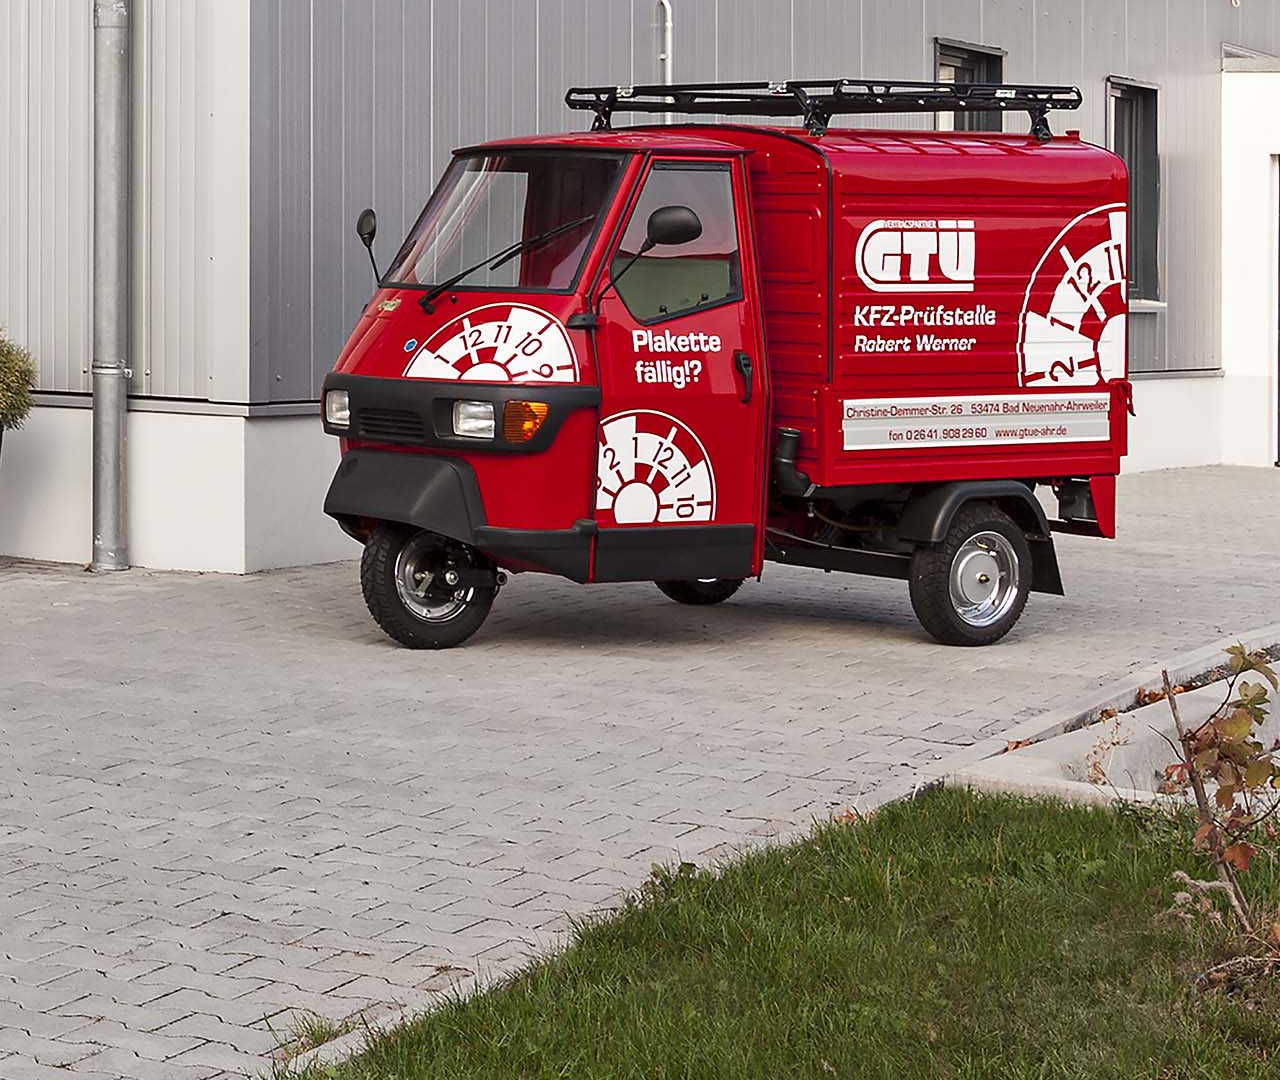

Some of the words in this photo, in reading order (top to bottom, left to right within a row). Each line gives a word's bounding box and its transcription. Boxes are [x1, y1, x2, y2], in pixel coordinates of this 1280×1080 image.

[863, 220, 975, 281] GTÜ
[1068, 262, 1101, 303] 12
[854, 305, 996, 326] KFZ-Prüfstelle
[460, 329, 484, 350] 12
[494, 325, 512, 343] 11
[515, 332, 542, 356] 10
[632, 330, 721, 353] Plakette
[854, 335, 911, 352] Robert
[916, 334, 976, 352] Werner
[532, 364, 553, 378] 9
[634, 360, 702, 389] fällig!?
[1049, 356, 1074, 382] 2
[846, 404, 948, 418] Christine-Demmer-Str.
[950, 404, 963, 414] 26
[971, 403, 999, 414] 53474
[1002, 403, 1019, 413] Bad
[1022, 401, 1108, 412] Neuenahr-Ahrweiler
[889, 430, 903, 440] fon
[994, 426, 1067, 439] www.gtue-ahr.de
[603, 447, 620, 470] 2
[632, 436, 638, 458] 1
[653, 441, 674, 470] 12
[671, 463, 691, 488] 11
[676, 494, 694, 518] 10
